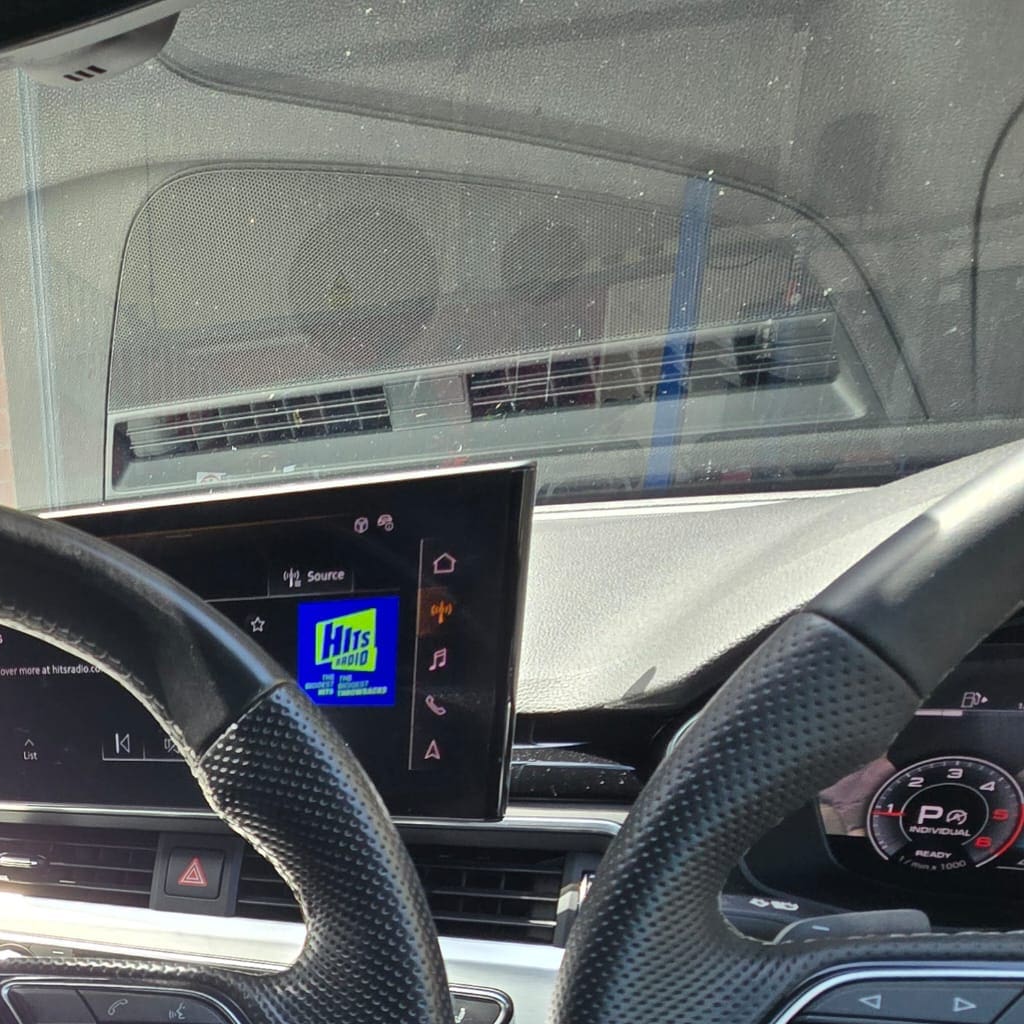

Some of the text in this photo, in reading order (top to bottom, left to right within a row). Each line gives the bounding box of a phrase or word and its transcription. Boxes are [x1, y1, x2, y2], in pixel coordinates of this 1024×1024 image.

[307, 570, 345, 583] Source
[19, 667, 40, 675] more
[42, 665, 51, 675] at
[52, 664, 104, 674] hitsradio.co
[23, 752, 38, 760] List
[946, 768, 963, 779] 3
[907, 777, 924, 788] 2
[979, 781, 995, 791] 4
[887, 803, 895, 813] 1
[917, 805, 944, 825] P
[992, 809, 1009, 820] 5
[909, 826, 971, 837] INDIVIDUAL
[975, 836, 992, 848] 6
[915, 849, 952, 859] READY
[940, 860, 967, 870] 1000
